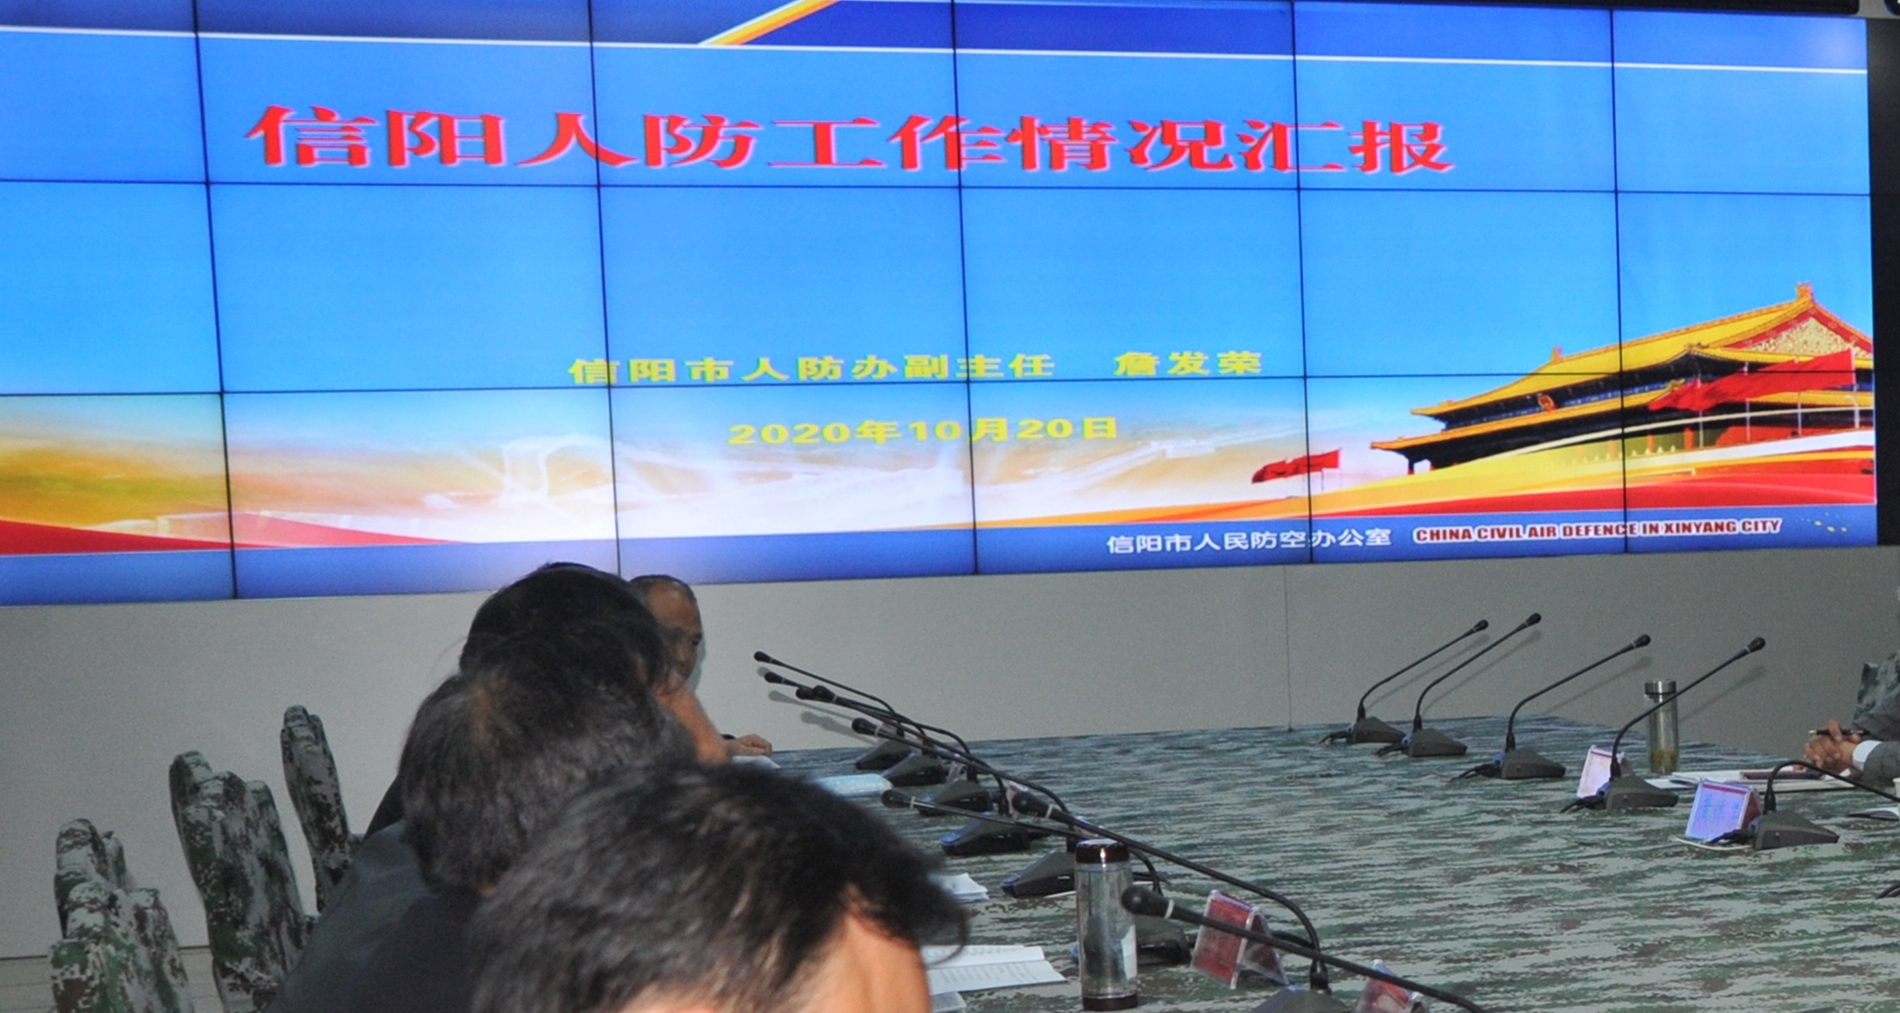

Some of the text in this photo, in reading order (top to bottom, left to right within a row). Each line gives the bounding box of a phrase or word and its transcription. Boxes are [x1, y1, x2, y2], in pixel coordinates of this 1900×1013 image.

[245, 104, 1455, 175] 信阳人防工作情况汇报
[568, 350, 1263, 385] 信阳市人防办副主任 詹发荣
[727, 416, 1119, 445] 2020年10月20日
[1106, 527, 1393, 555] 信阳市人民防空办公室
[1414, 518, 1781, 542] CHINA CIVIL AIR DEFENCE IN XINYANG CITY
